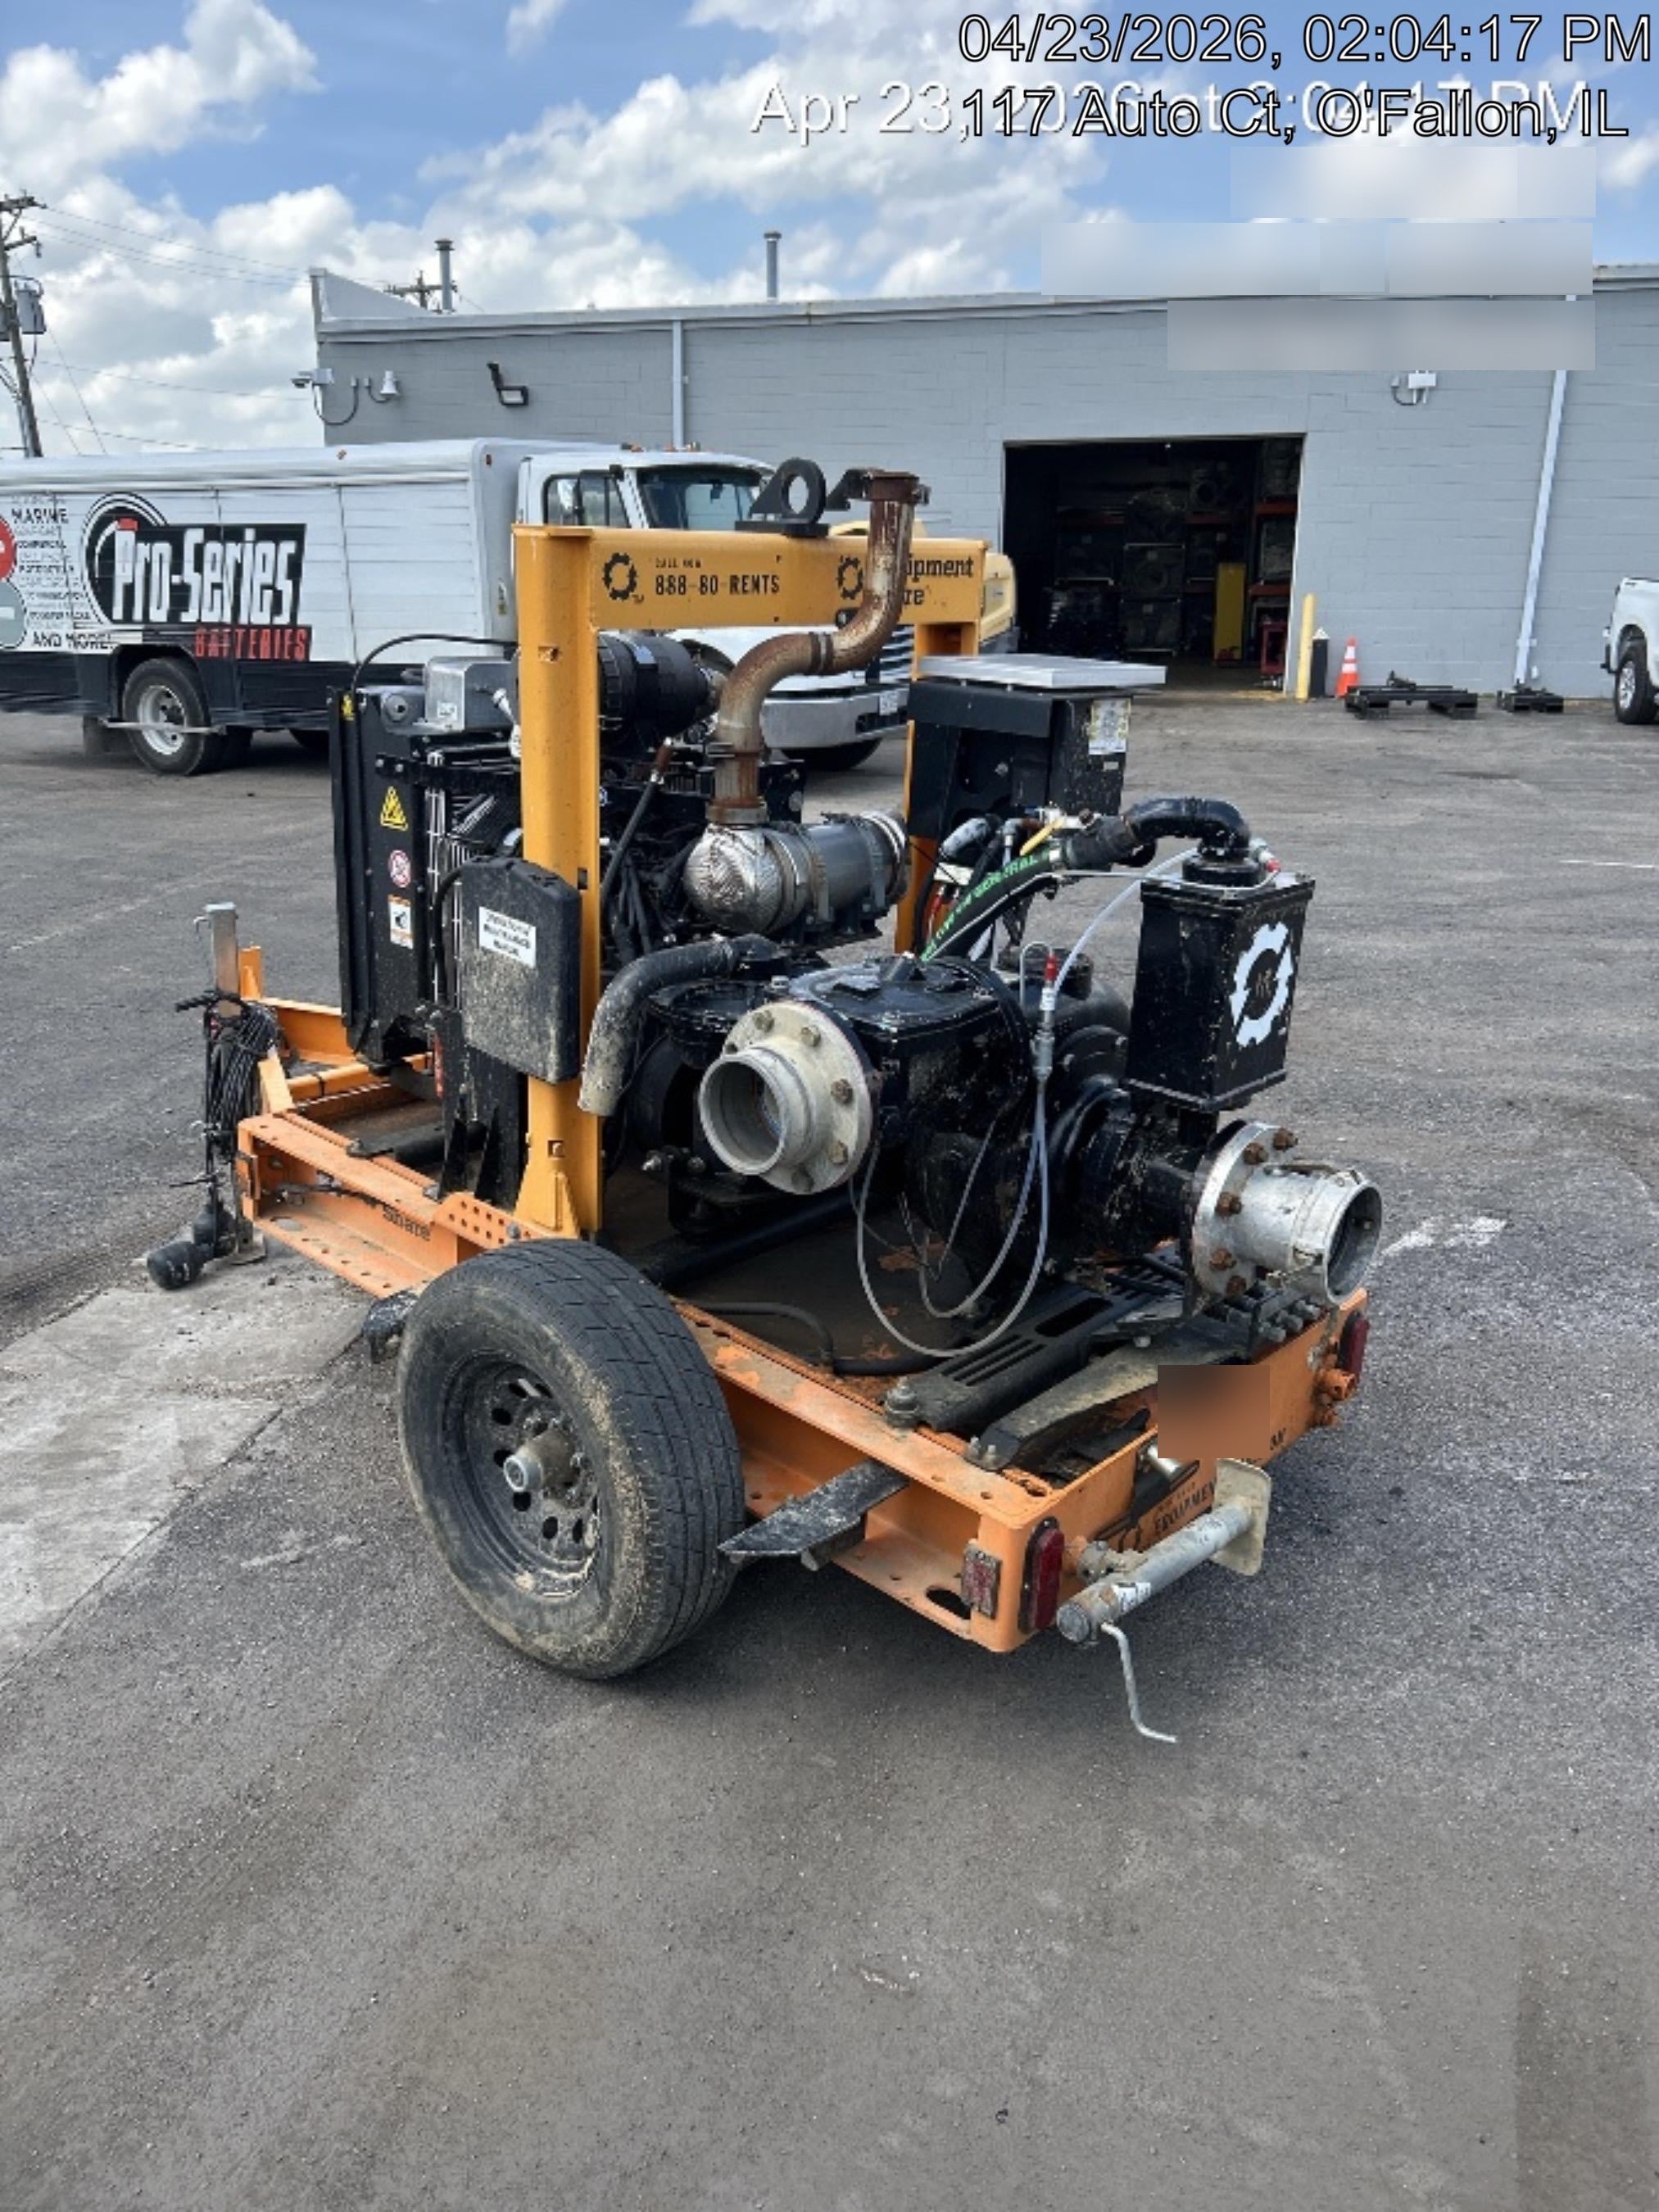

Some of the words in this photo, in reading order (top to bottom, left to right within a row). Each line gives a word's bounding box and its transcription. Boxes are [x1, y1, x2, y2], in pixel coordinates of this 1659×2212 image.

[11, 508, 70, 524] MARINE
[111, 527, 297, 625] Pro-Series
[34, 631, 62, 647] AND
[195, 628, 308, 662] BATTERIES
